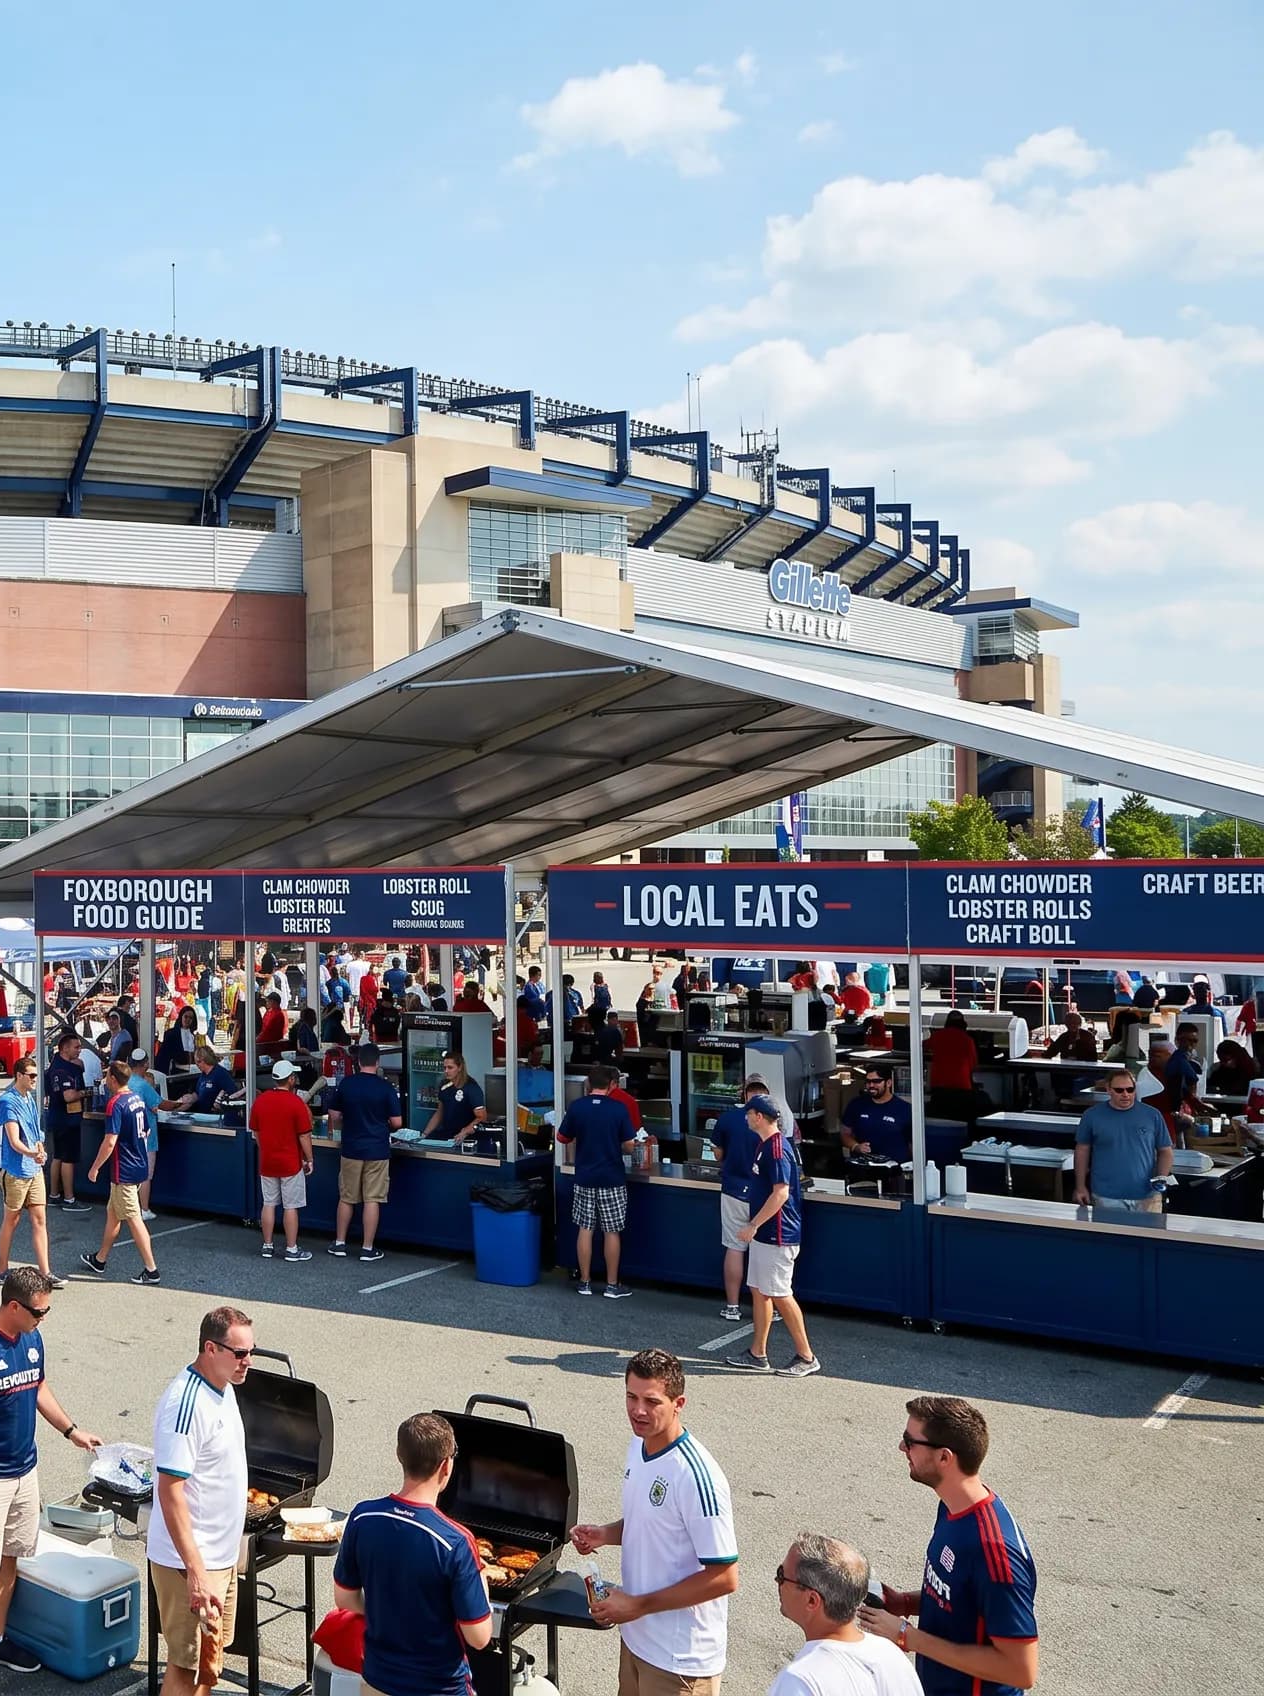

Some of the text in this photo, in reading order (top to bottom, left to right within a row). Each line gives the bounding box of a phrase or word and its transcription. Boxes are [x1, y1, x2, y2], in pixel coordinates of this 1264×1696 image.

[769, 558, 852, 617] Gillette
[63, 879, 213, 903] FOXBOROUGH
[263, 879, 350, 895] CLAM CHOWDER
[383, 878, 471, 894] LOBSTER ROLL
[946, 874, 1092, 894] CLAM CHOWDER
[1143, 873, 1264, 895] CRAFT BEER
[73, 904, 204, 930] FOOD GUIDE
[268, 899, 346, 914] LOBSTER ROLL
[623, 884, 818, 929] LOCAL EATS
[948, 899, 1092, 920] LOBSTER ROLLS
[966, 924, 1076, 945] CRAFT BOLL
